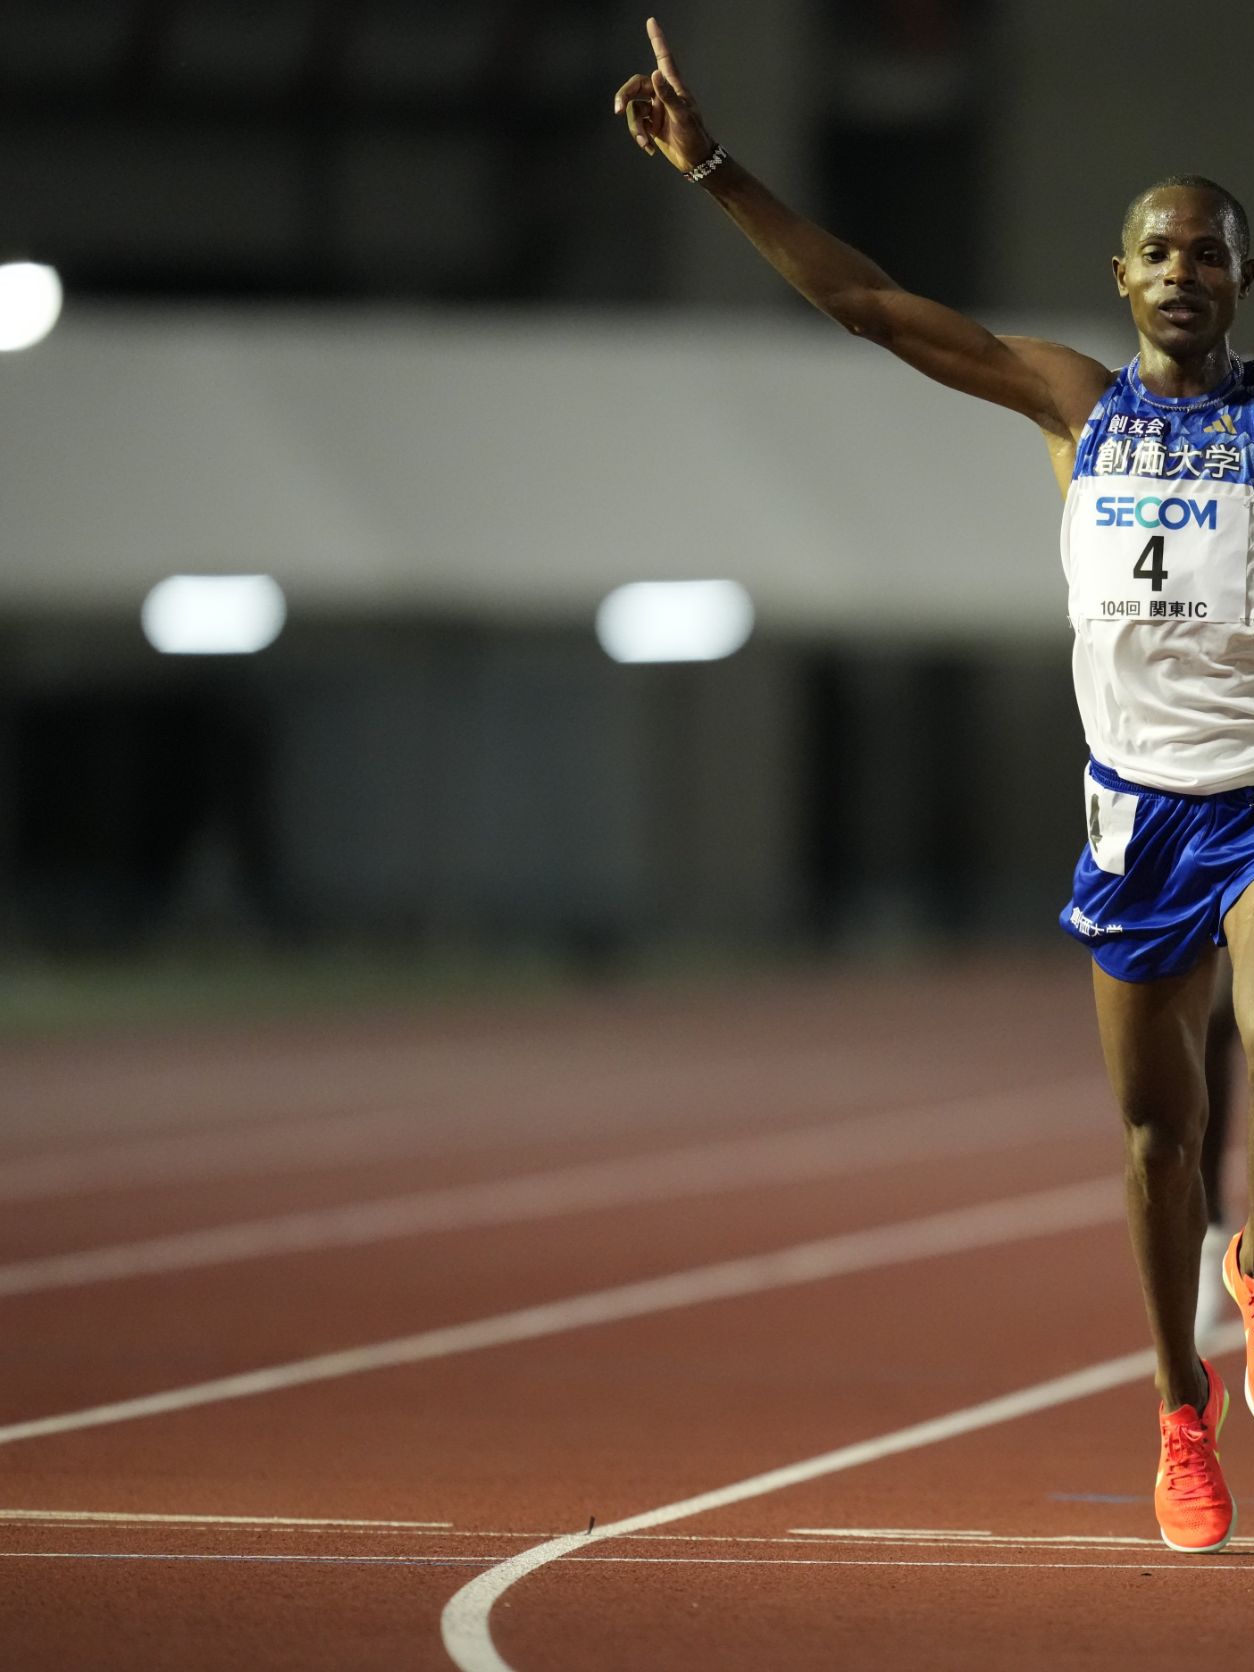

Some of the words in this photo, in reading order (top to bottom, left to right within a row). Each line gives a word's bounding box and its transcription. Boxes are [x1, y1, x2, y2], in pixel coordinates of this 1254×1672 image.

[1108, 414, 1164, 434] 創友会
[1095, 438, 1239, 478] 創価大学
[1095, 496, 1218, 530] SECOM
[1132, 535, 1169, 592] 4
[1100, 600, 1141, 616] 104回
[1150, 600, 1208, 618] 関東IC
